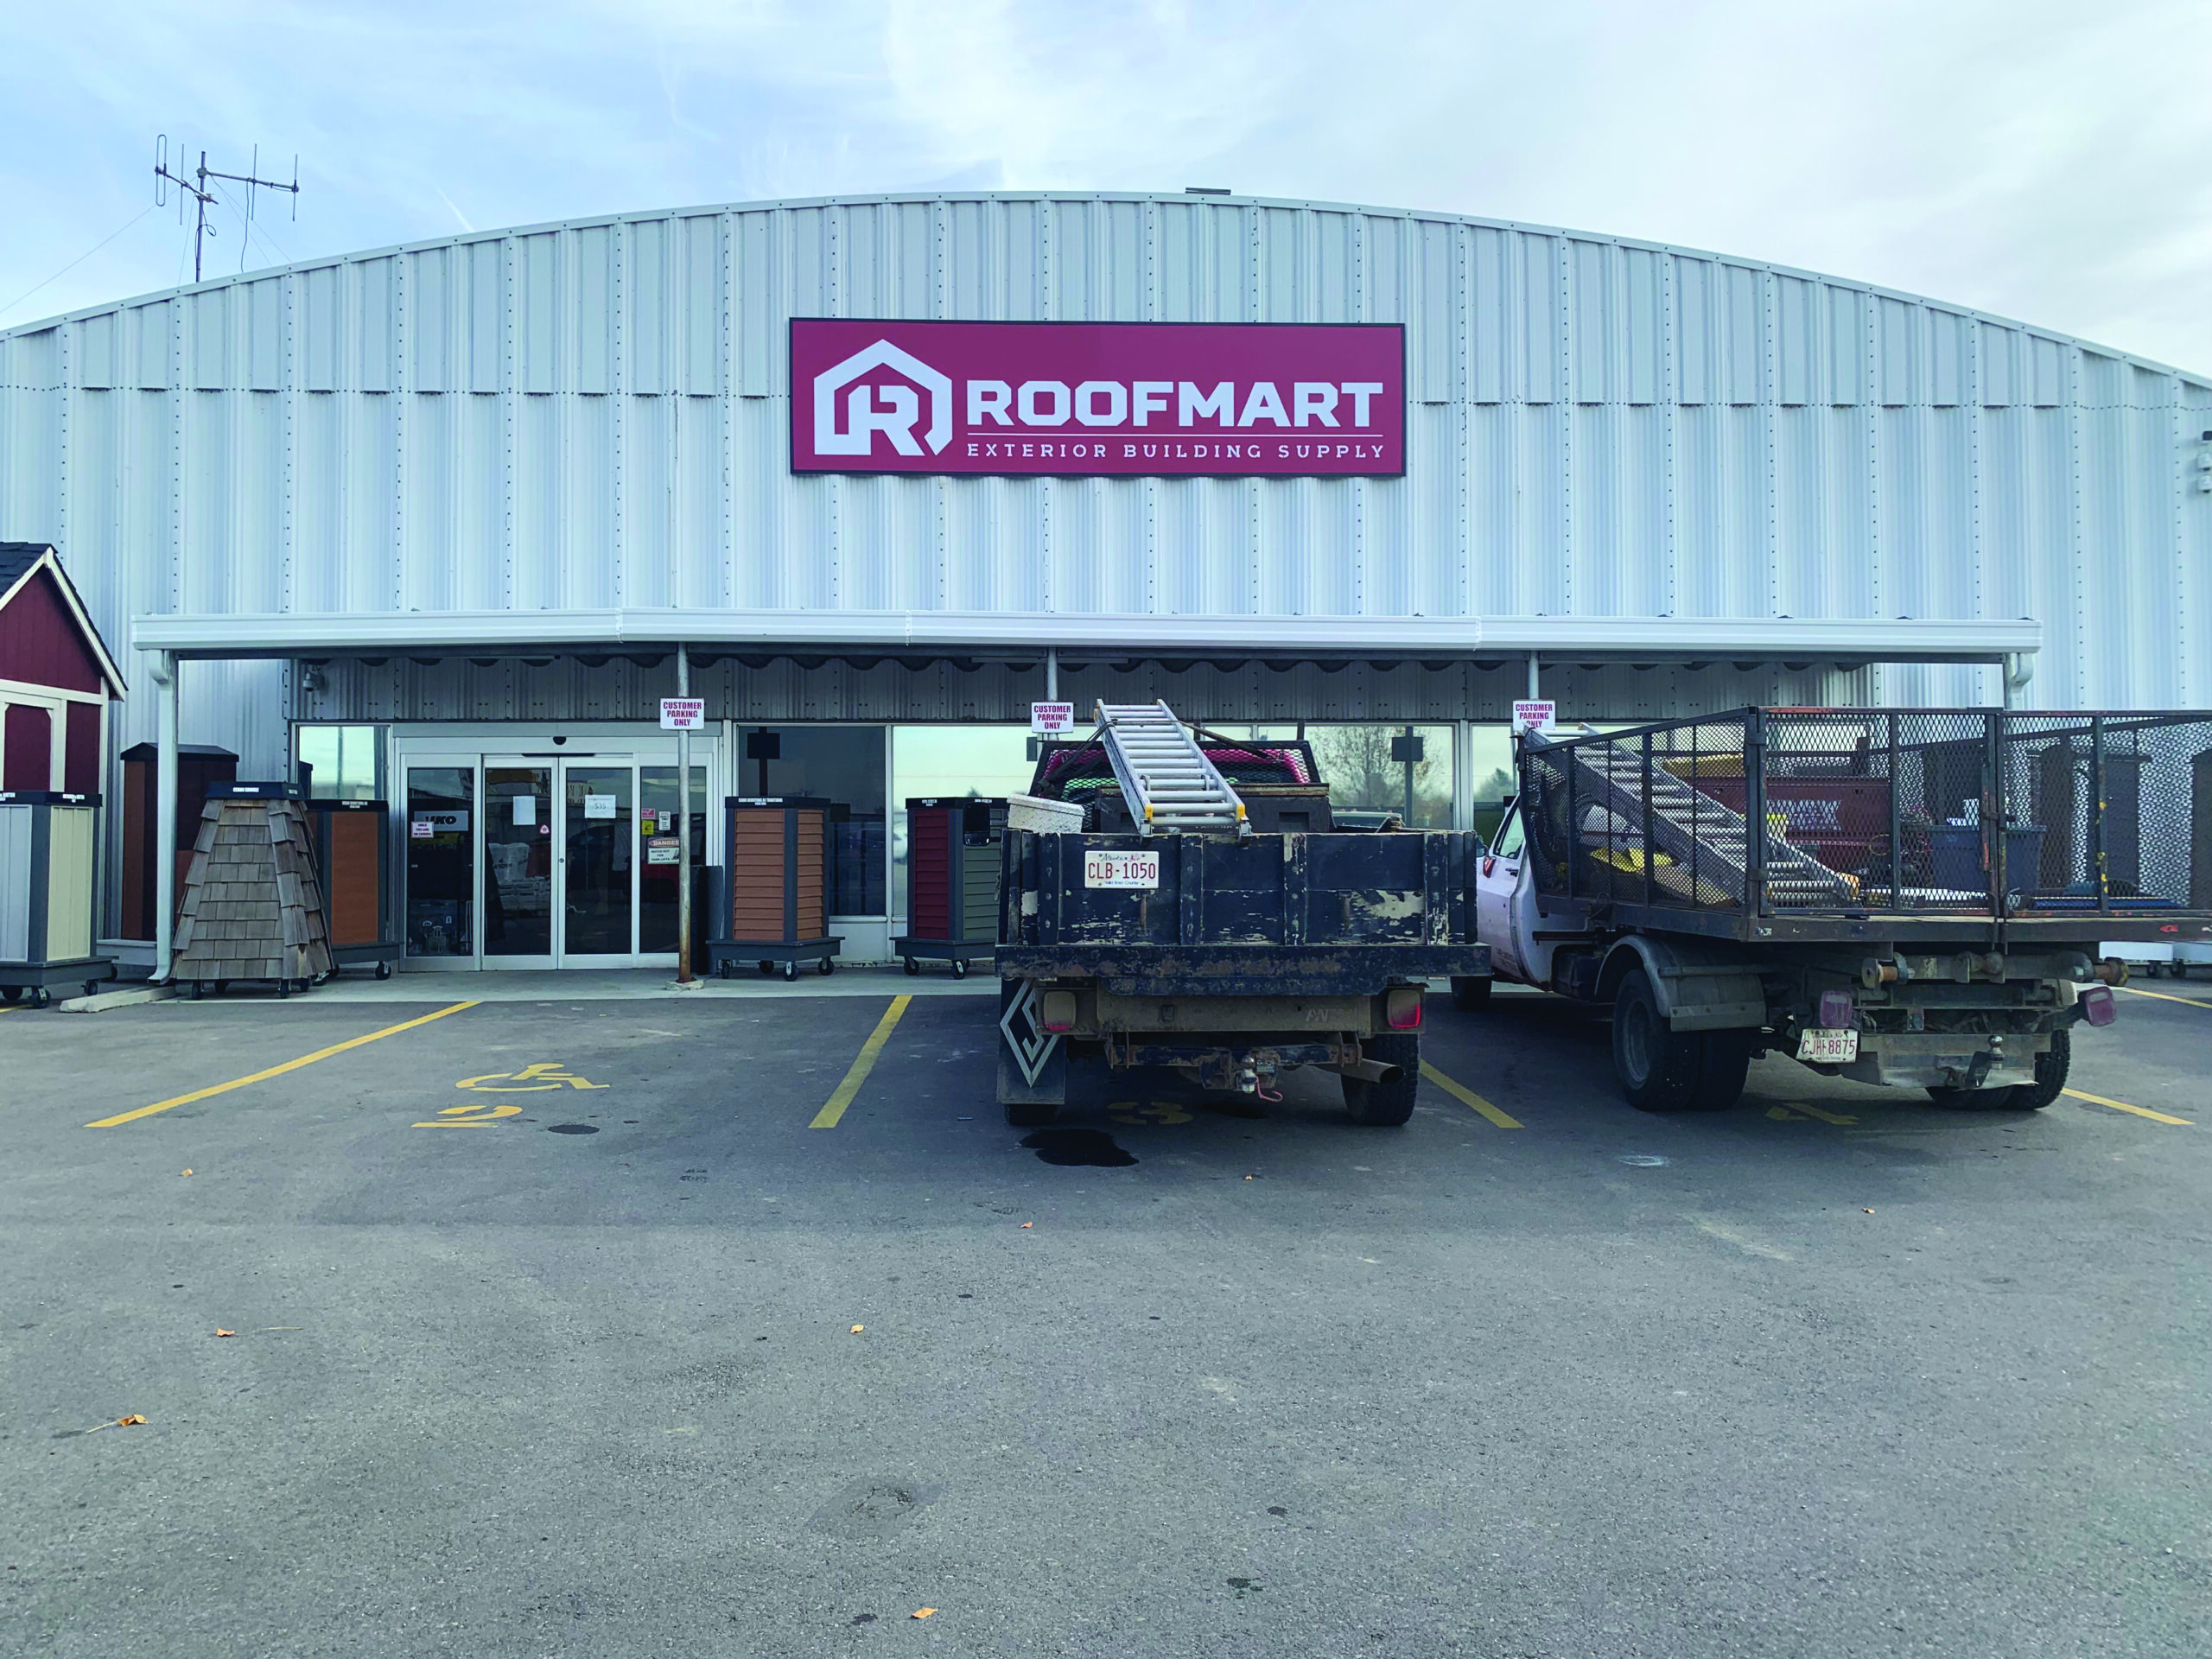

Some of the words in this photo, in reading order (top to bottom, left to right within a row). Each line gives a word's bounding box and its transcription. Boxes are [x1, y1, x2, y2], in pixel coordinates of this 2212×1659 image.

[967, 379, 1383, 428] ROOFMART
[967, 443, 1107, 458] EXTERIOR
[1123, 443, 1262, 459] BUILDING
[1278, 444, 1383, 459] SUPPLY
[663, 701, 702, 709] CUSTOMER
[674, 718, 691, 727] ONLY
[1037, 713, 1068, 721] PARKING
[1088, 862, 1156, 880] CLB-1050
[410, 1104, 523, 1128] 2
[1108, 1101, 1194, 1126] 3
